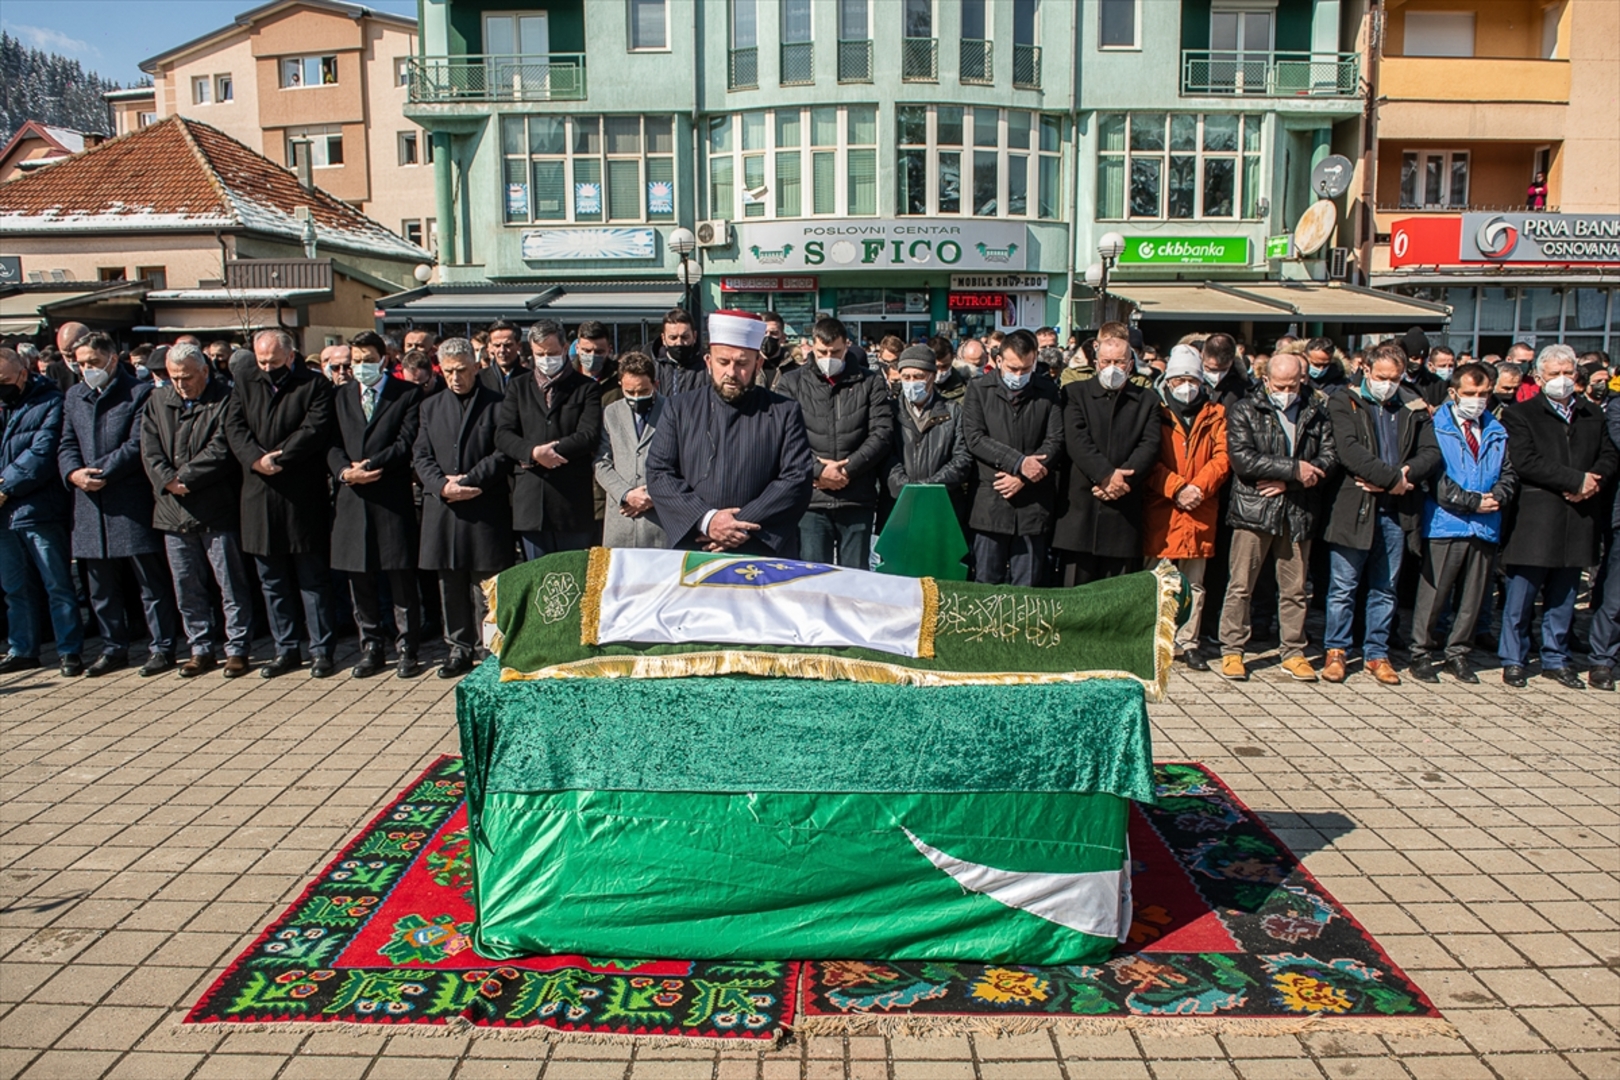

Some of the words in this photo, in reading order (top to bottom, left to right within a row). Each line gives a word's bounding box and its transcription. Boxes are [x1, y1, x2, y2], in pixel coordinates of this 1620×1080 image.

[804, 226, 886, 236] POSLOVNI
[893, 226, 961, 235] CENTAR
[1525, 219, 1570, 236] PRVA
[1157, 241, 1225, 256] ckbbanka
[1543, 241, 1620, 256] OSNOVANA
[948, 295, 1003, 306] FUTROLE
